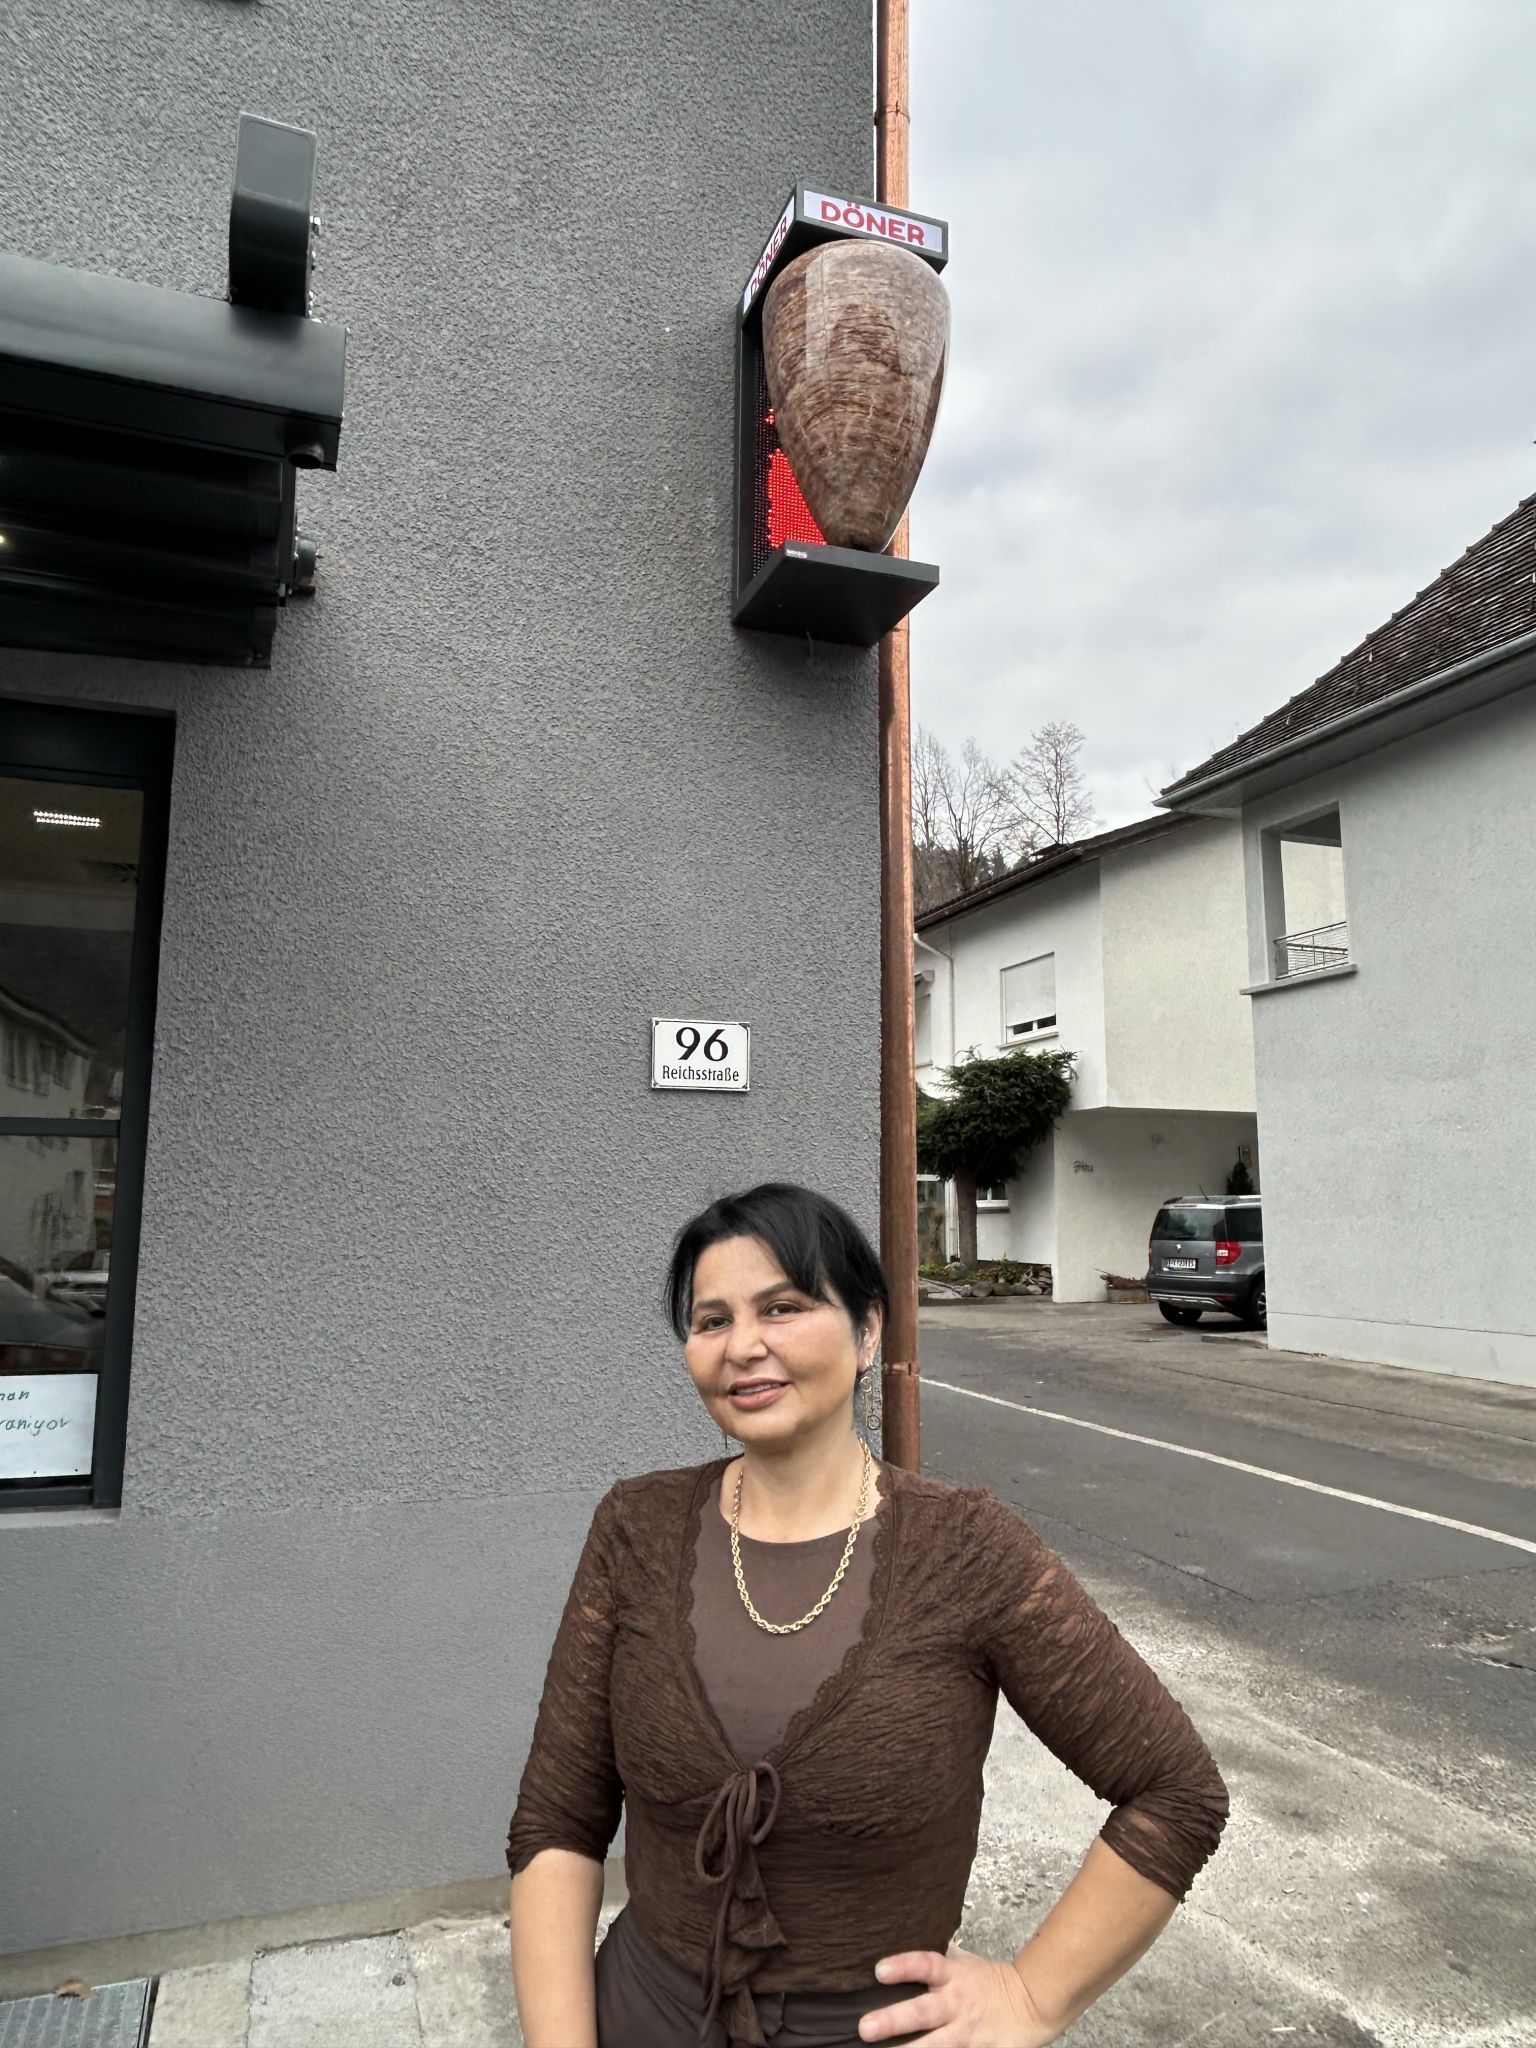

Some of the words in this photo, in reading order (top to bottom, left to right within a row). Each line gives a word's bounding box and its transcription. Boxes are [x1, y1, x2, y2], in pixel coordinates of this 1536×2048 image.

[821, 200, 925, 246] DÖNER
[750, 215, 787, 297] DÖNER
[676, 1026, 729, 1062] 96
[662, 1065, 739, 1082] Reichsstraße
